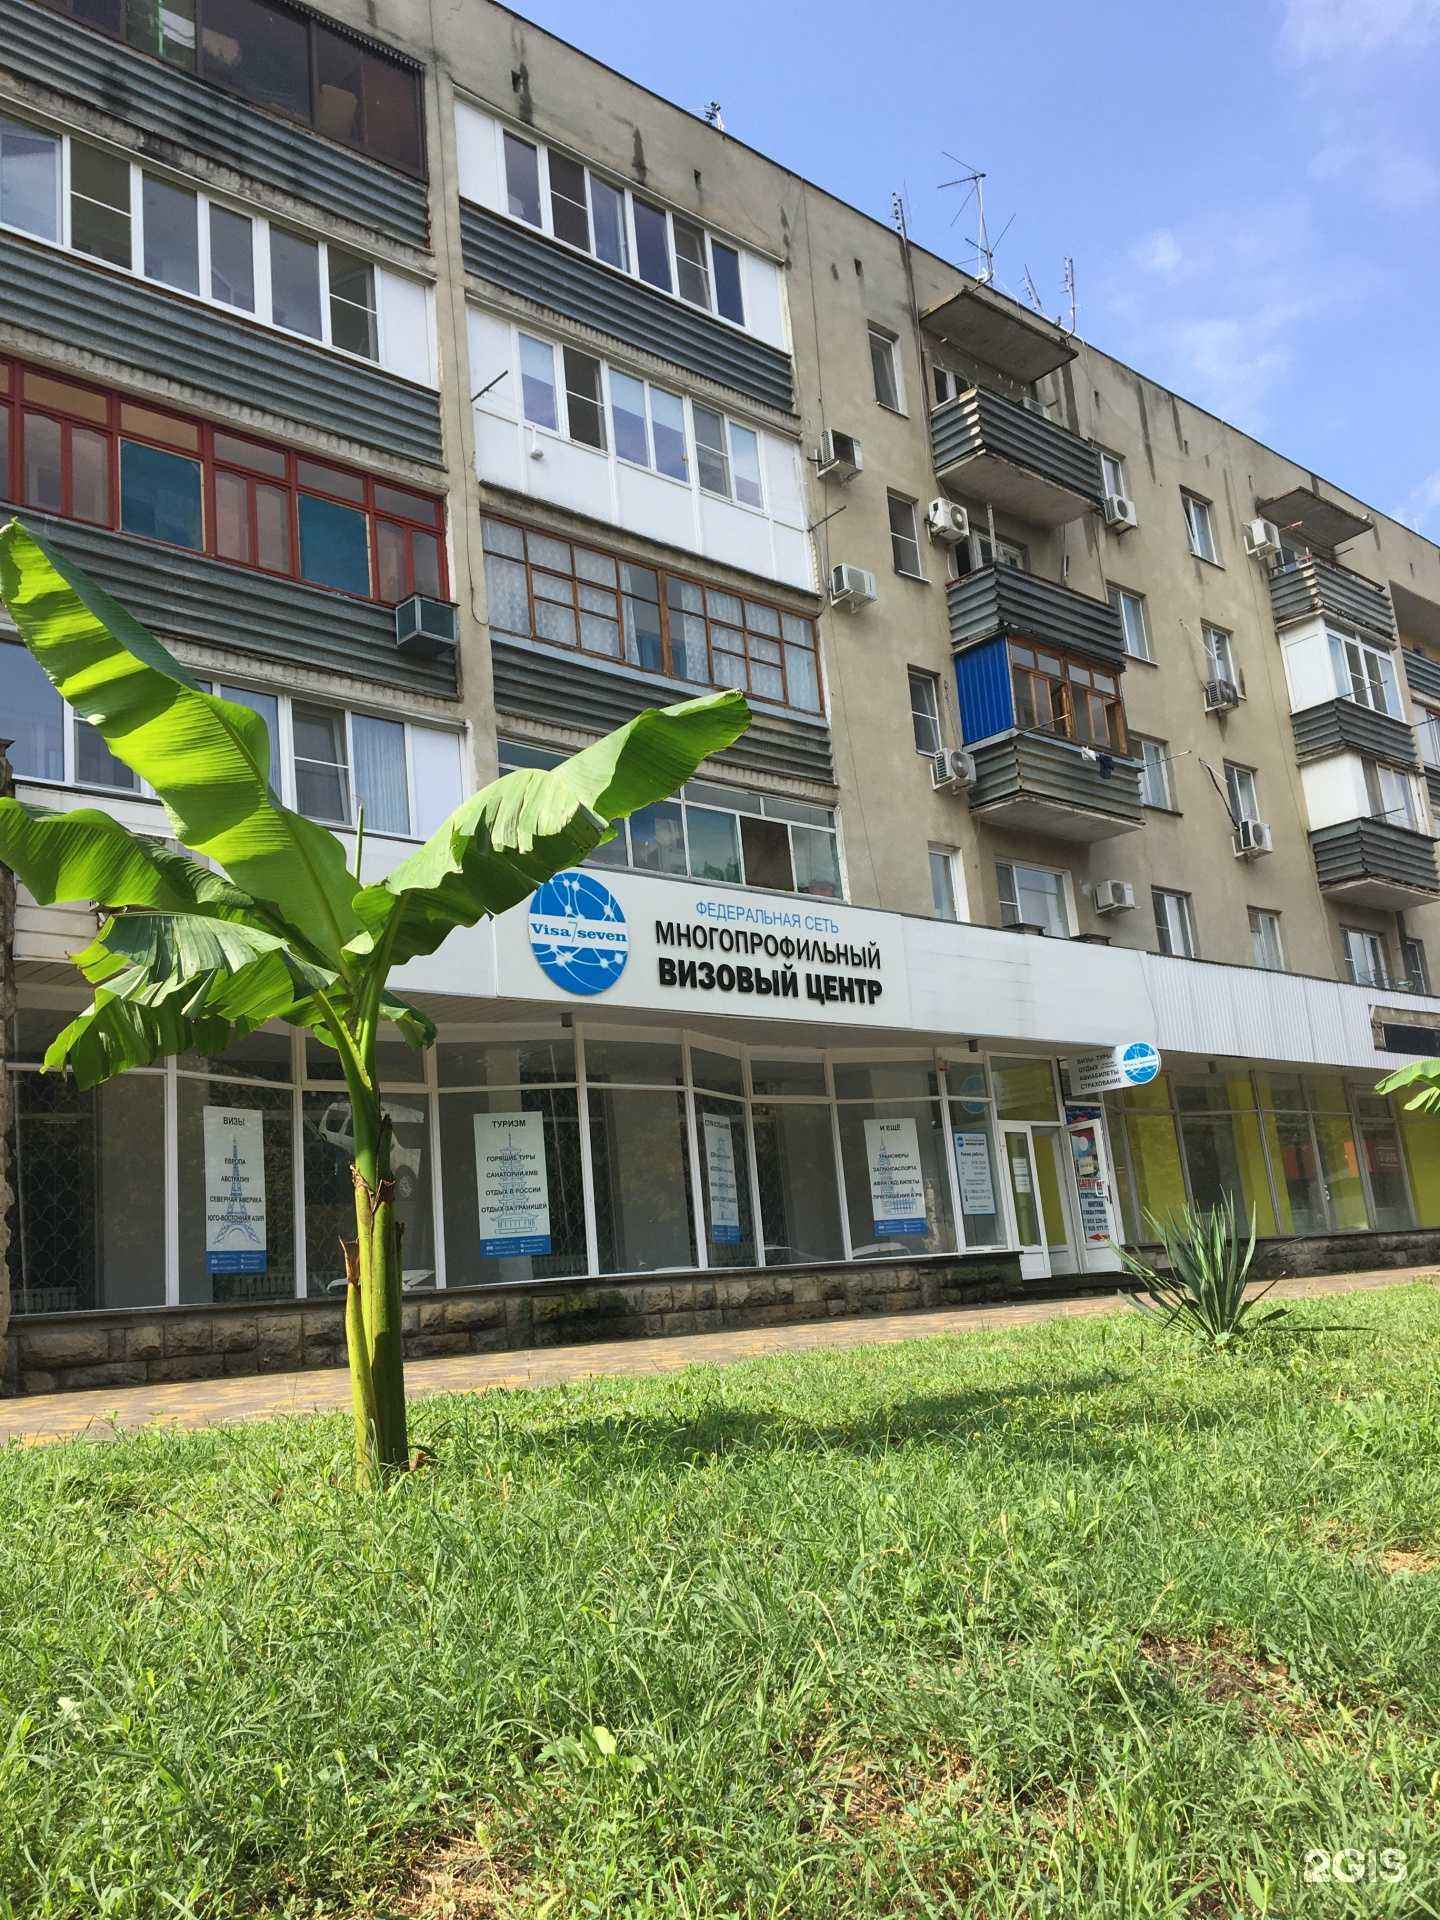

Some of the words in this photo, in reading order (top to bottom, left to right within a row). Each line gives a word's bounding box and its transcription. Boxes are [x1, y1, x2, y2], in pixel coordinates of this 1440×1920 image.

[696, 901, 800, 928] ФЕДЕРАЛЬНАЯ
[804, 915, 839, 934] СЕТЬ
[531, 922, 571, 937] Visa
[577, 928, 627, 942] seven
[655, 920, 881, 970] МНОГОПРОФИЛЬНЫЙ
[658, 957, 799, 998] ВИЗОВЫЙ
[805, 973, 883, 1005] ЦЕНТР
[223, 1116, 245, 1126] ВИЗЫ
[492, 1119, 526, 1128] ТУРИЗМ
